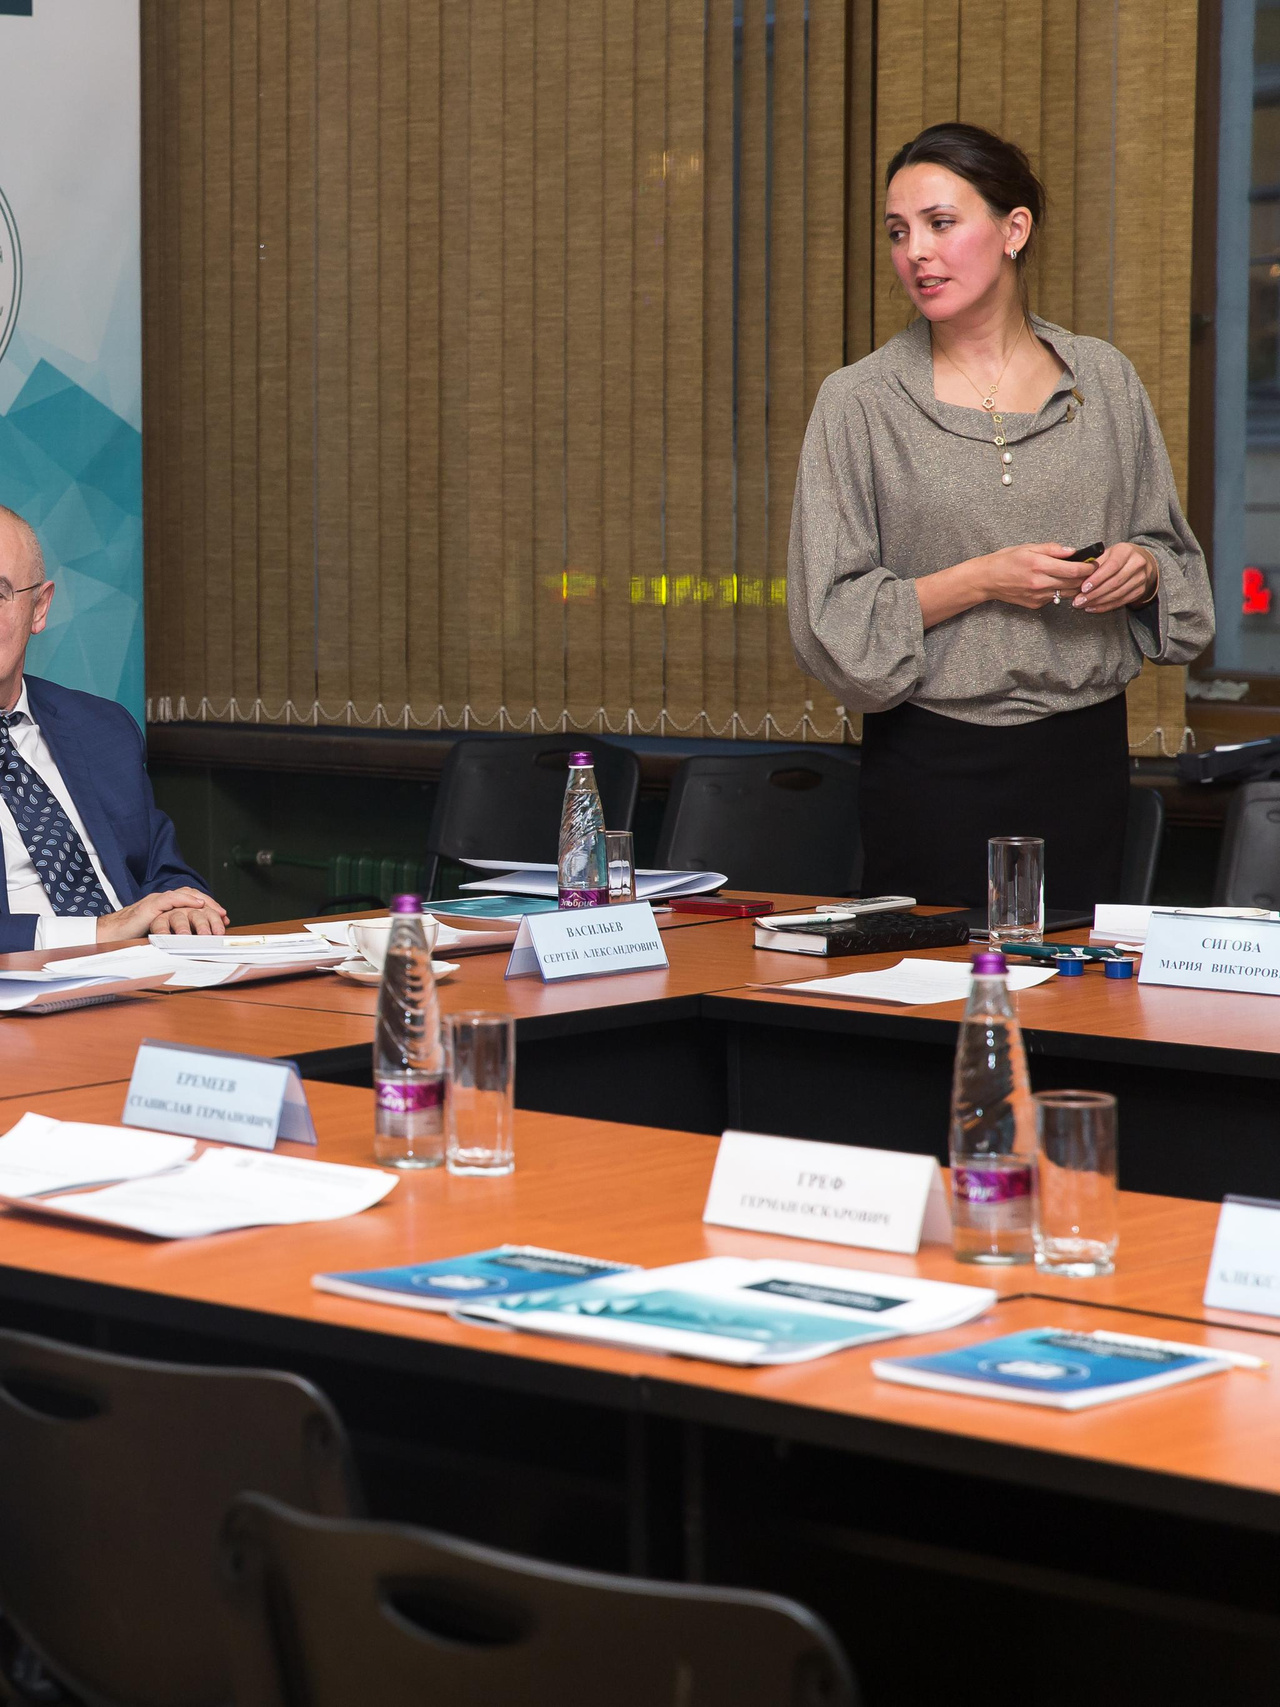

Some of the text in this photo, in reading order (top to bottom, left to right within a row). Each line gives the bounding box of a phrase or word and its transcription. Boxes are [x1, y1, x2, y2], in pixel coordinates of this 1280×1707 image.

[566, 921, 624, 938] ВАСИЛЬЕВ
[543, 941, 659, 964] СЕРГЕЙ АЛЕКСАНДРОВИЧ
[1201, 937, 1262, 953] СИГОВА
[1159, 959, 1280, 979] МАРИЯ ВИКТОРОВ
[175, 1071, 238, 1094] ЕРЕМЕЕВ
